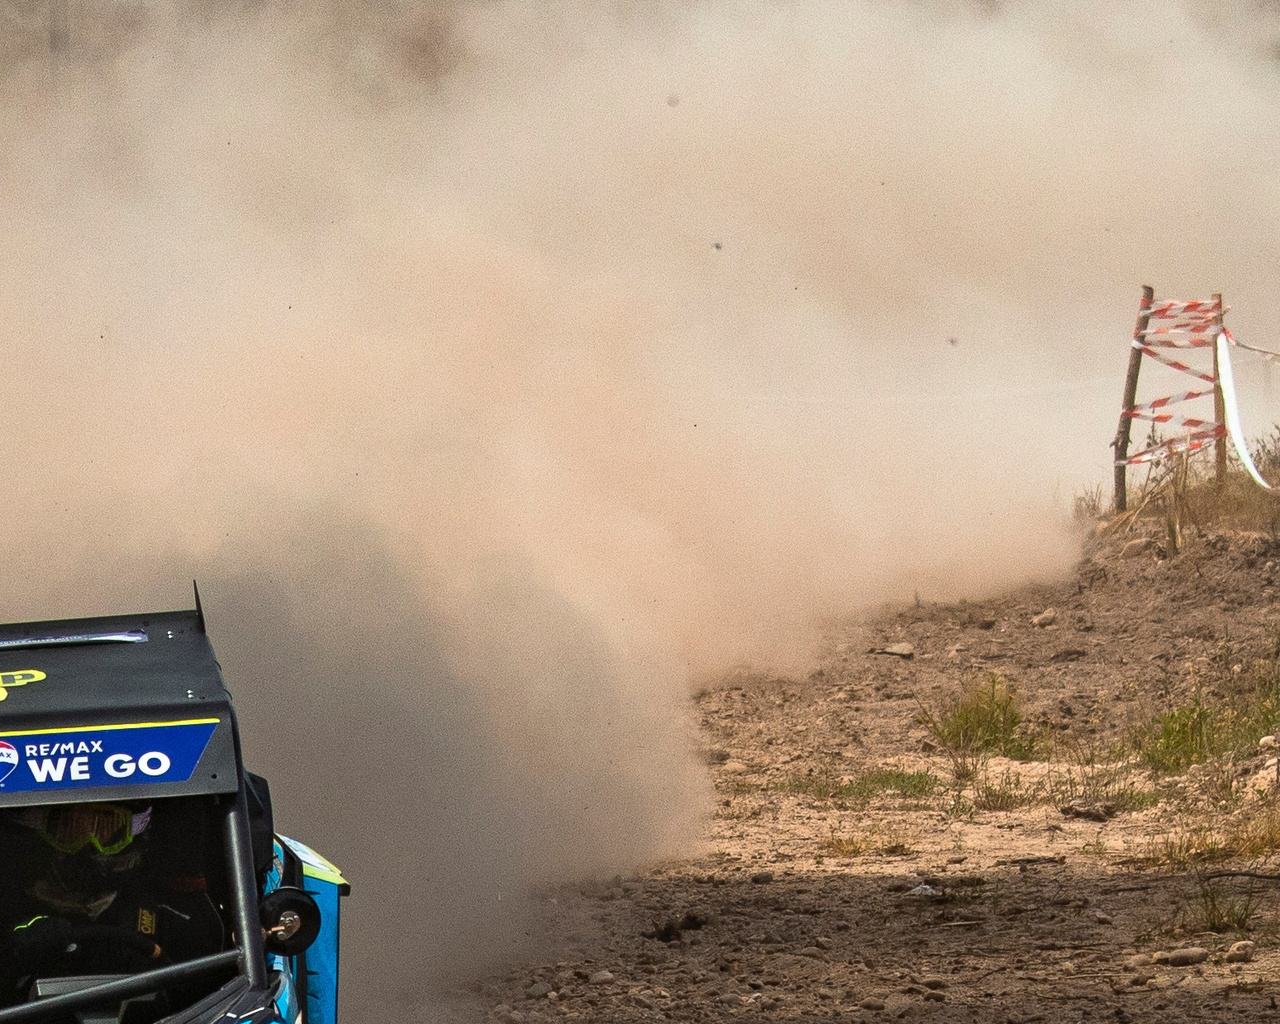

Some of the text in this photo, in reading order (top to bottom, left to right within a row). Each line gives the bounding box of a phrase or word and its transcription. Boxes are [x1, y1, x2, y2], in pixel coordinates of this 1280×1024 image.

[26, 740, 103, 757] RE/MAX
[27, 751, 170, 782] WE GO
